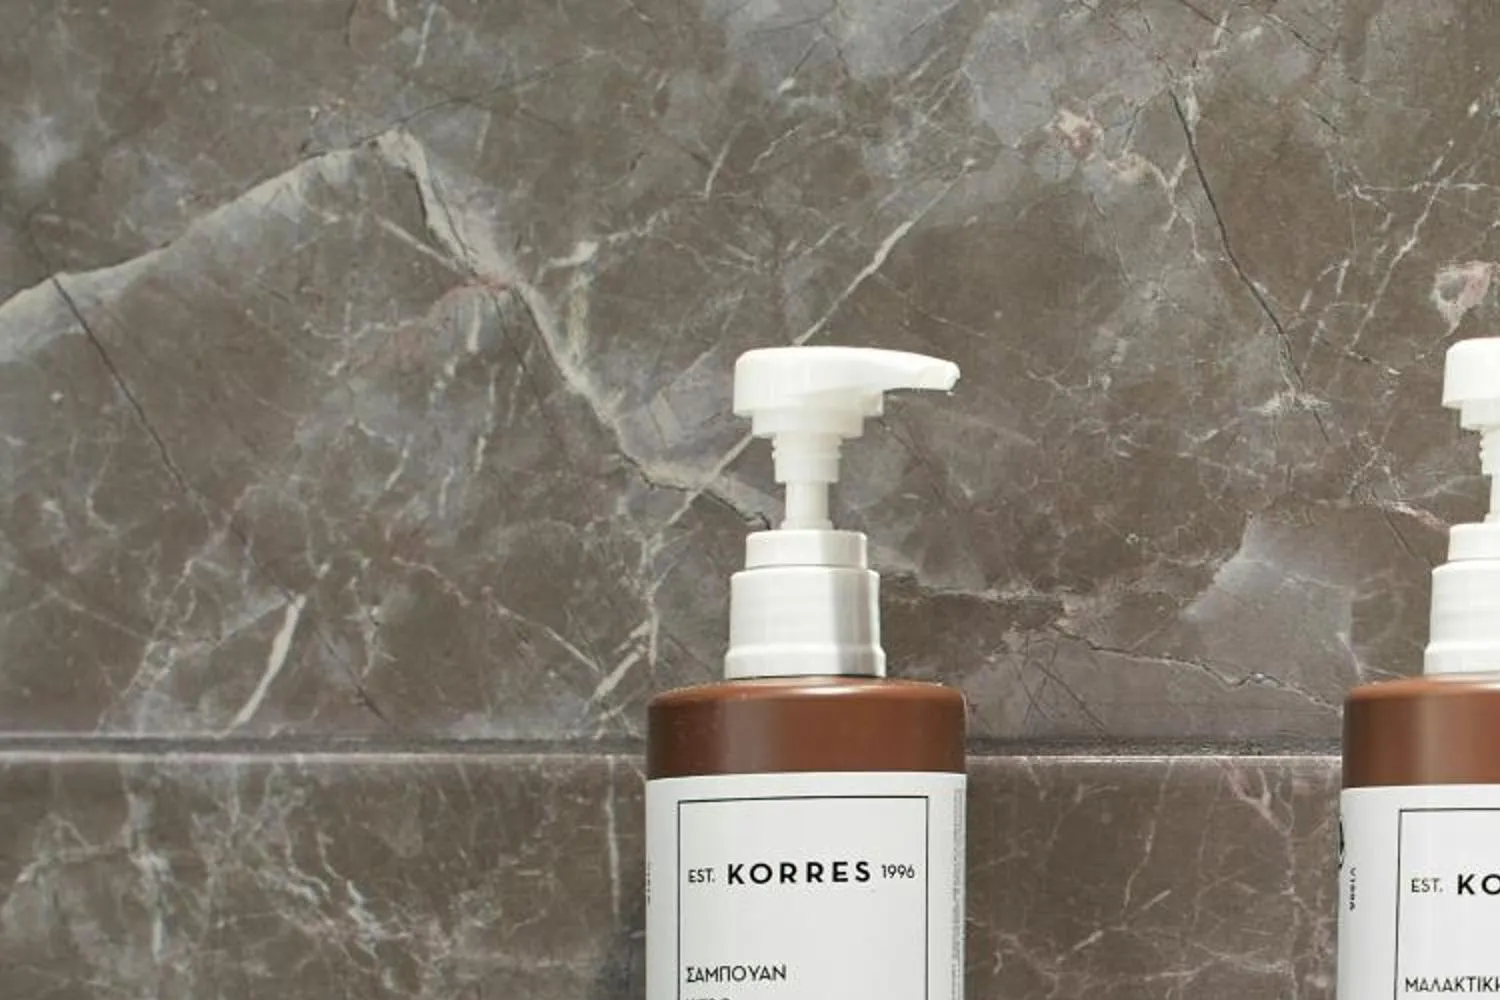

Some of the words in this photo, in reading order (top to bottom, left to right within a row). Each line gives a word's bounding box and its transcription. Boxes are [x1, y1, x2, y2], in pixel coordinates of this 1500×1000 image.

[688, 868, 715, 883] EST.
[727, 861, 871, 885] KORRES
[881, 864, 915, 880] 1996
[1410, 877, 1443, 893] EST.
[687, 964, 787, 983] ΣΑΜΠΟΥΑΝ
